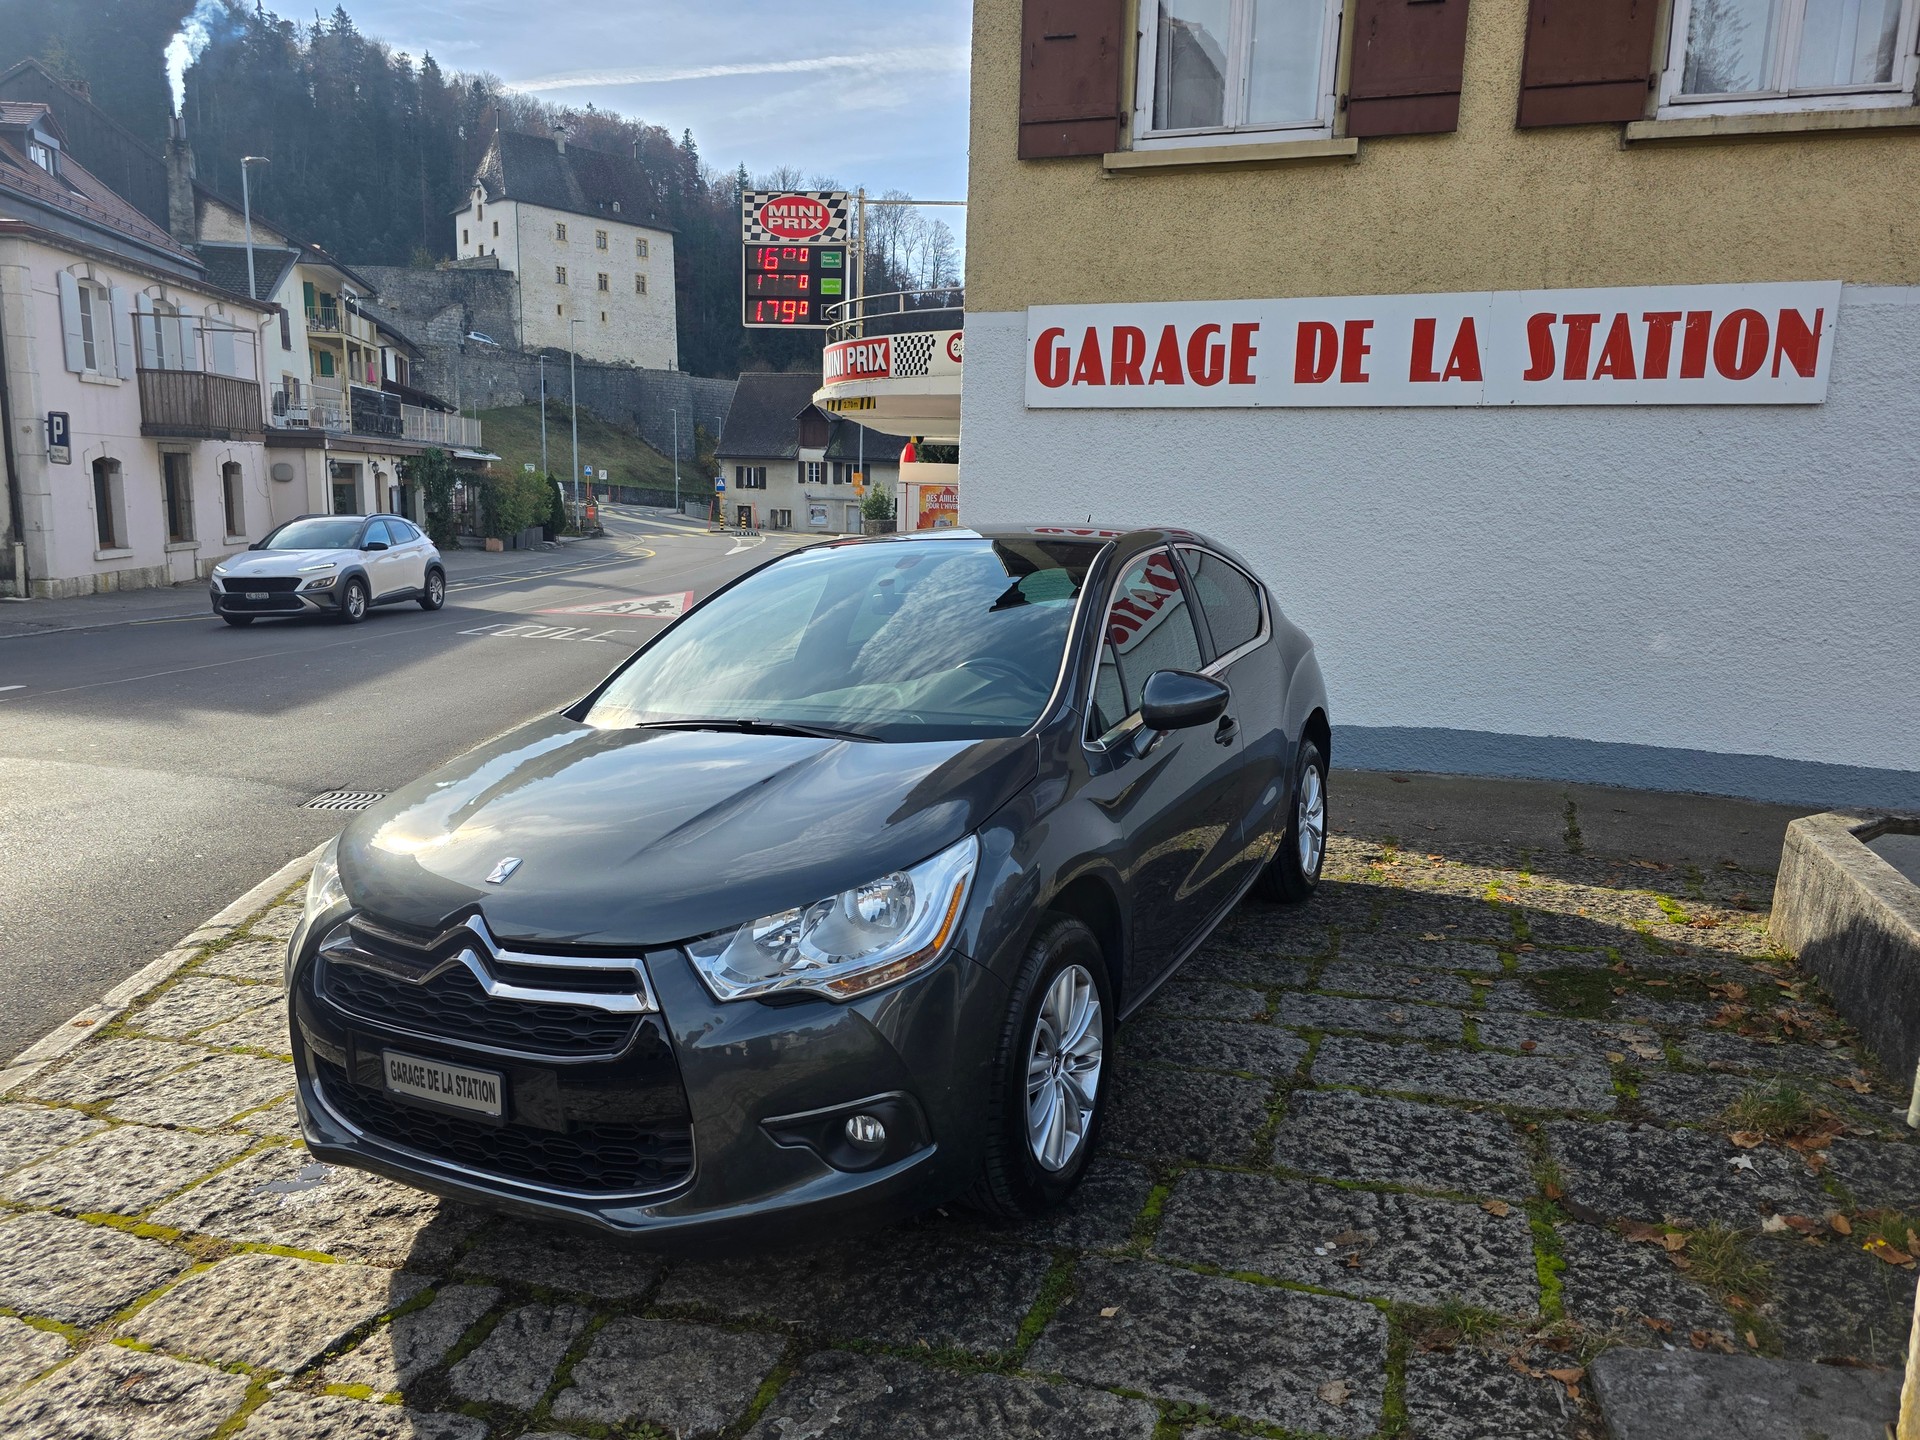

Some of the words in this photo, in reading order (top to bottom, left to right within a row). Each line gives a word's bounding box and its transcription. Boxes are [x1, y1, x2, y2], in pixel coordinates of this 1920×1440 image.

[767, 204, 823, 217] MINI
[767, 218, 823, 230] PRIX
[1033, 322, 1260, 389] GARAGE
[1294, 319, 1375, 385] DE
[1408, 316, 1483, 383] LA
[1522, 307, 1825, 382] STATION
[825, 348, 844, 379] MINI
[846, 342, 888, 375] PRIX
[53, 416, 63, 444] P
[926, 494, 938, 502] DES
[456, 623, 638, 643] ECOLE
[390, 1059, 426, 1089] GARAGE
[427, 1068, 440, 1092] DE
[441, 1071, 454, 1096] LA
[455, 1074, 497, 1104] STATION
